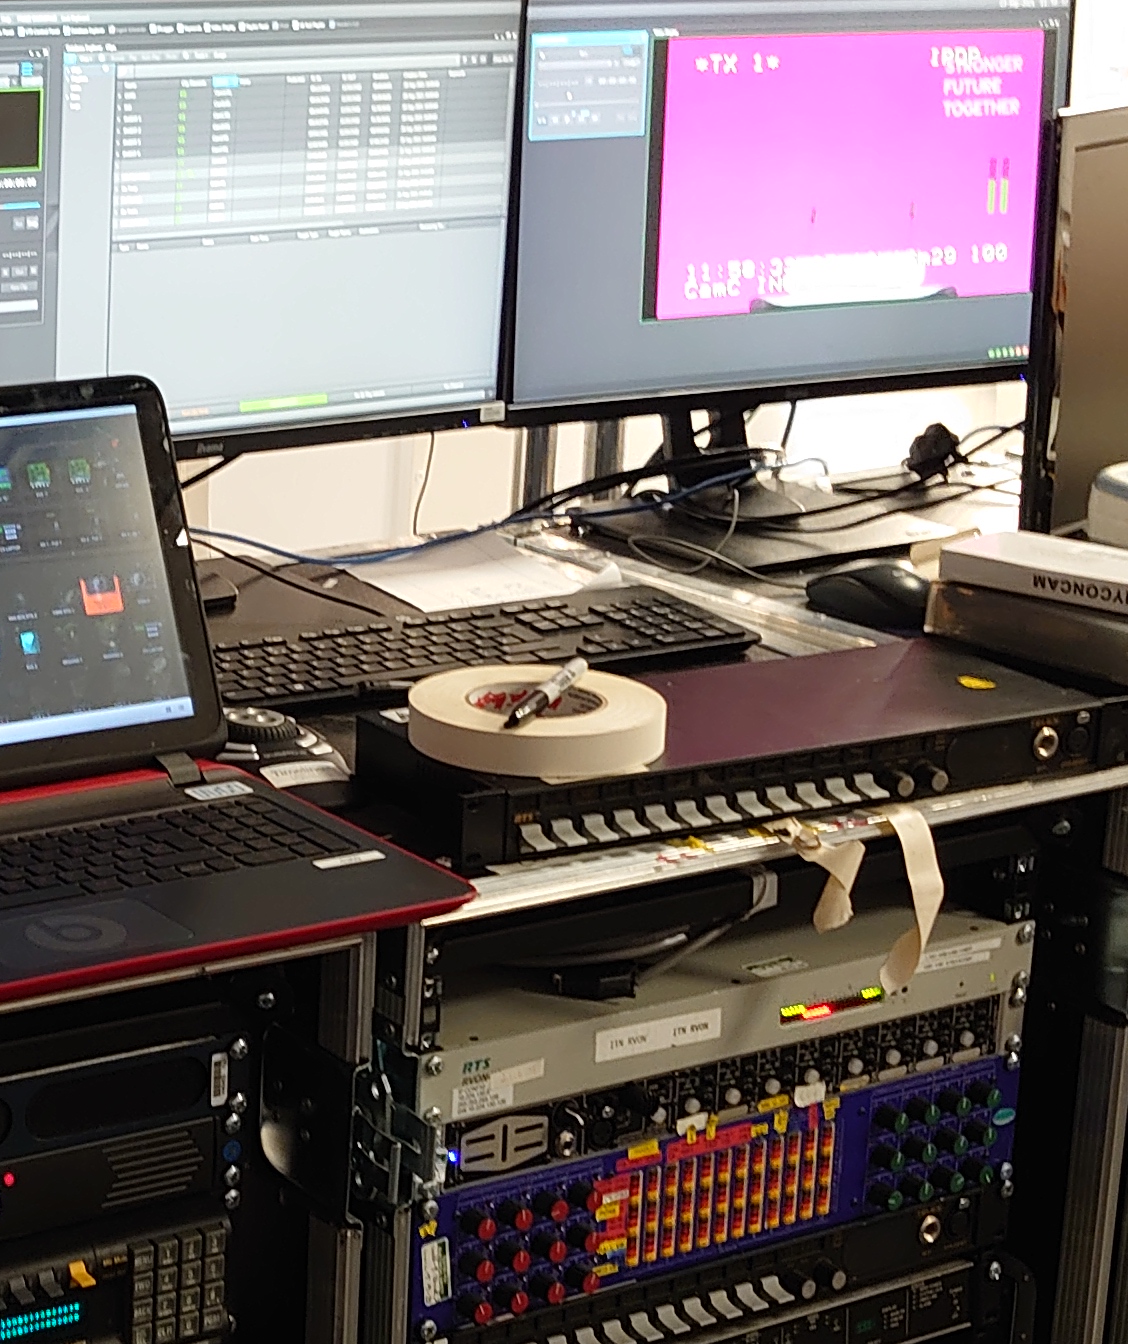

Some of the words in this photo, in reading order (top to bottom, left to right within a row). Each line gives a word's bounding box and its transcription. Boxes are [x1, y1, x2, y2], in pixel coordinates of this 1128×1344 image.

[944, 55, 1024, 75] STRONGER
[942, 77, 1002, 96] FUTURE
[942, 99, 1020, 117] TOGETHER
[462, 1056, 491, 1075] RTS
